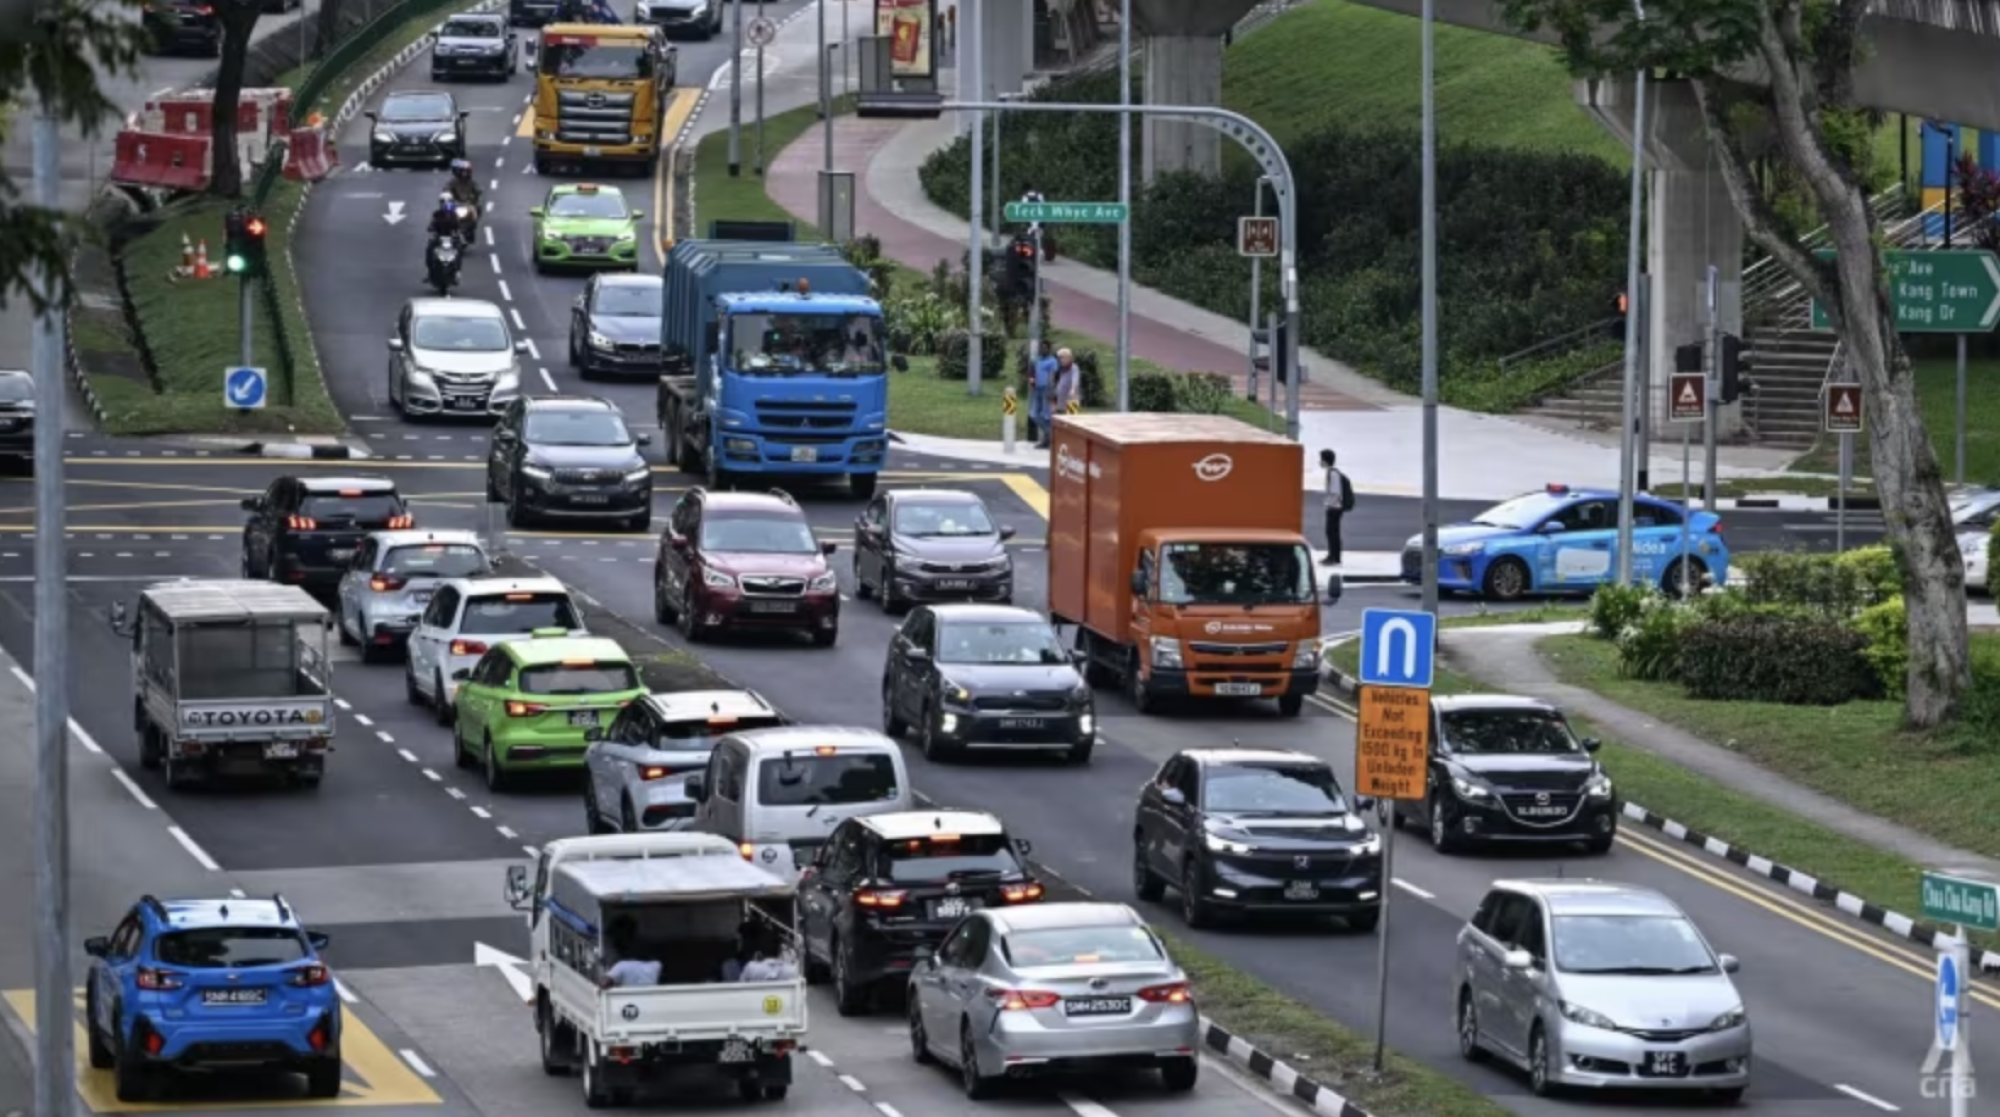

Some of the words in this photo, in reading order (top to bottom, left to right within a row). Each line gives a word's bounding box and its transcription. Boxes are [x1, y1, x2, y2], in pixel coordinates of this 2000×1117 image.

[1014, 205, 1044, 218] Teck
[1051, 205, 1089, 220] Whye
[1094, 205, 1120, 218] Ave
[1909, 259, 1934, 275] Ave
[1898, 282, 1933, 301] Kang
[1942, 282, 1978, 299] Town
[1898, 304, 1933, 324] Kang
[1940, 304, 1956, 320] Dr
[1371, 690, 1419, 706] Vehicles
[203, 709, 305, 725] TOYOTA
[1383, 707, 1405, 722] Not
[1364, 723, 1422, 745] Exceeding
[1361, 741, 1390, 757] 1500
[1394, 745, 1407, 762] kg
[1367, 759, 1416, 776] Unladen
[1371, 777, 1410, 795] Weight
